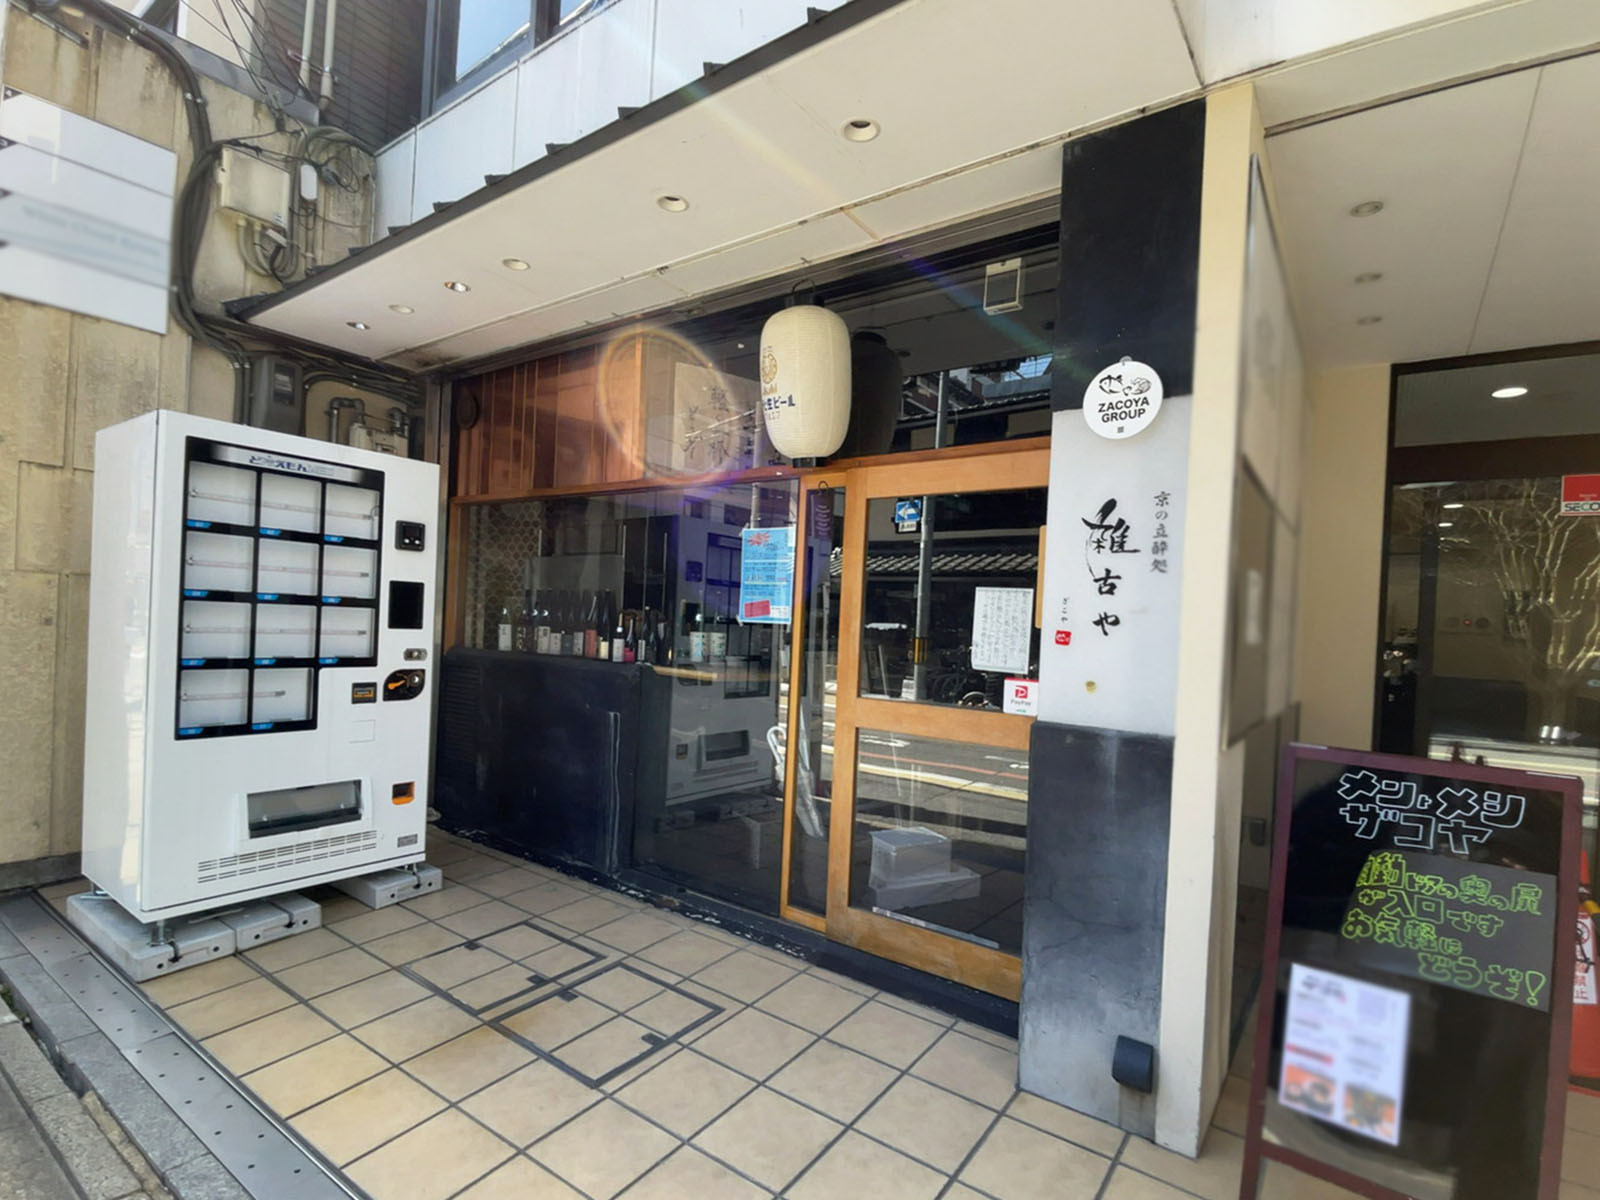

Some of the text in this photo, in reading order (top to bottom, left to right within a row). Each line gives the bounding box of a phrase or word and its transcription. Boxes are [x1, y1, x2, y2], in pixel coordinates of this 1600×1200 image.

[1098, 396, 1150, 413] ZACOYA
[1101, 408, 1146, 423] GROUP
[1081, 498, 1141, 636] 雑古や
[1339, 803, 1493, 855] ザコヤ
[1342, 908, 1463, 956] お気軽に
[1358, 889, 1504, 937] が入口です
[1418, 952, 1546, 1006] どうぞ!
